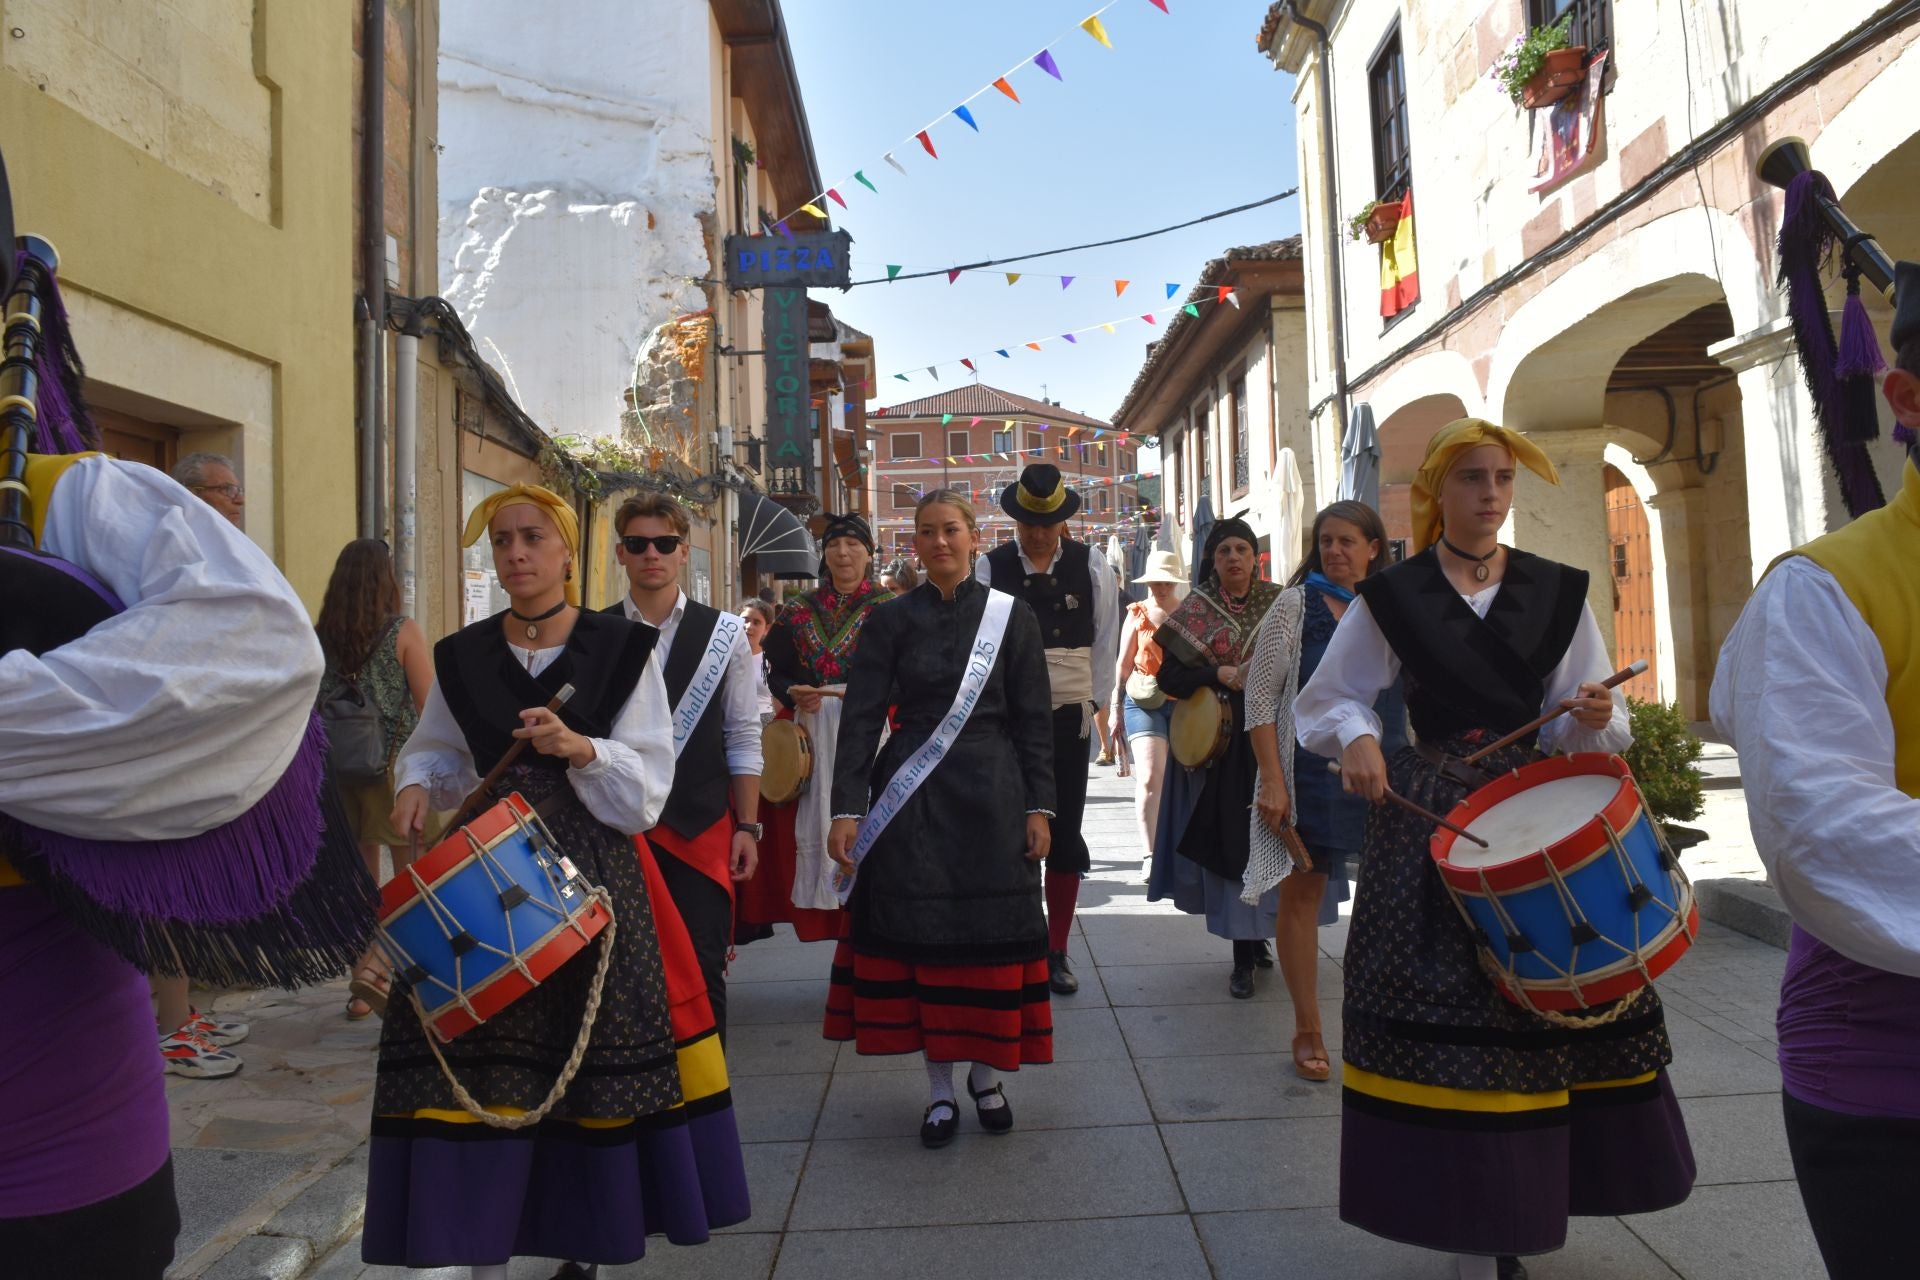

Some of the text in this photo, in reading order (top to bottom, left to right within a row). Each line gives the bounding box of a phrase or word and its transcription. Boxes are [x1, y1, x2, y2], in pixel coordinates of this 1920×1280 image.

[738, 247, 834, 272] PIZZA
[773, 291, 801, 457] VICTORIA
[673, 618, 739, 742] Caballero 2025
[968, 638, 995, 688] 2025
[941, 688, 977, 735] Dama
[886, 736, 944, 804] Pisuerga
[879, 802, 895, 821] de
